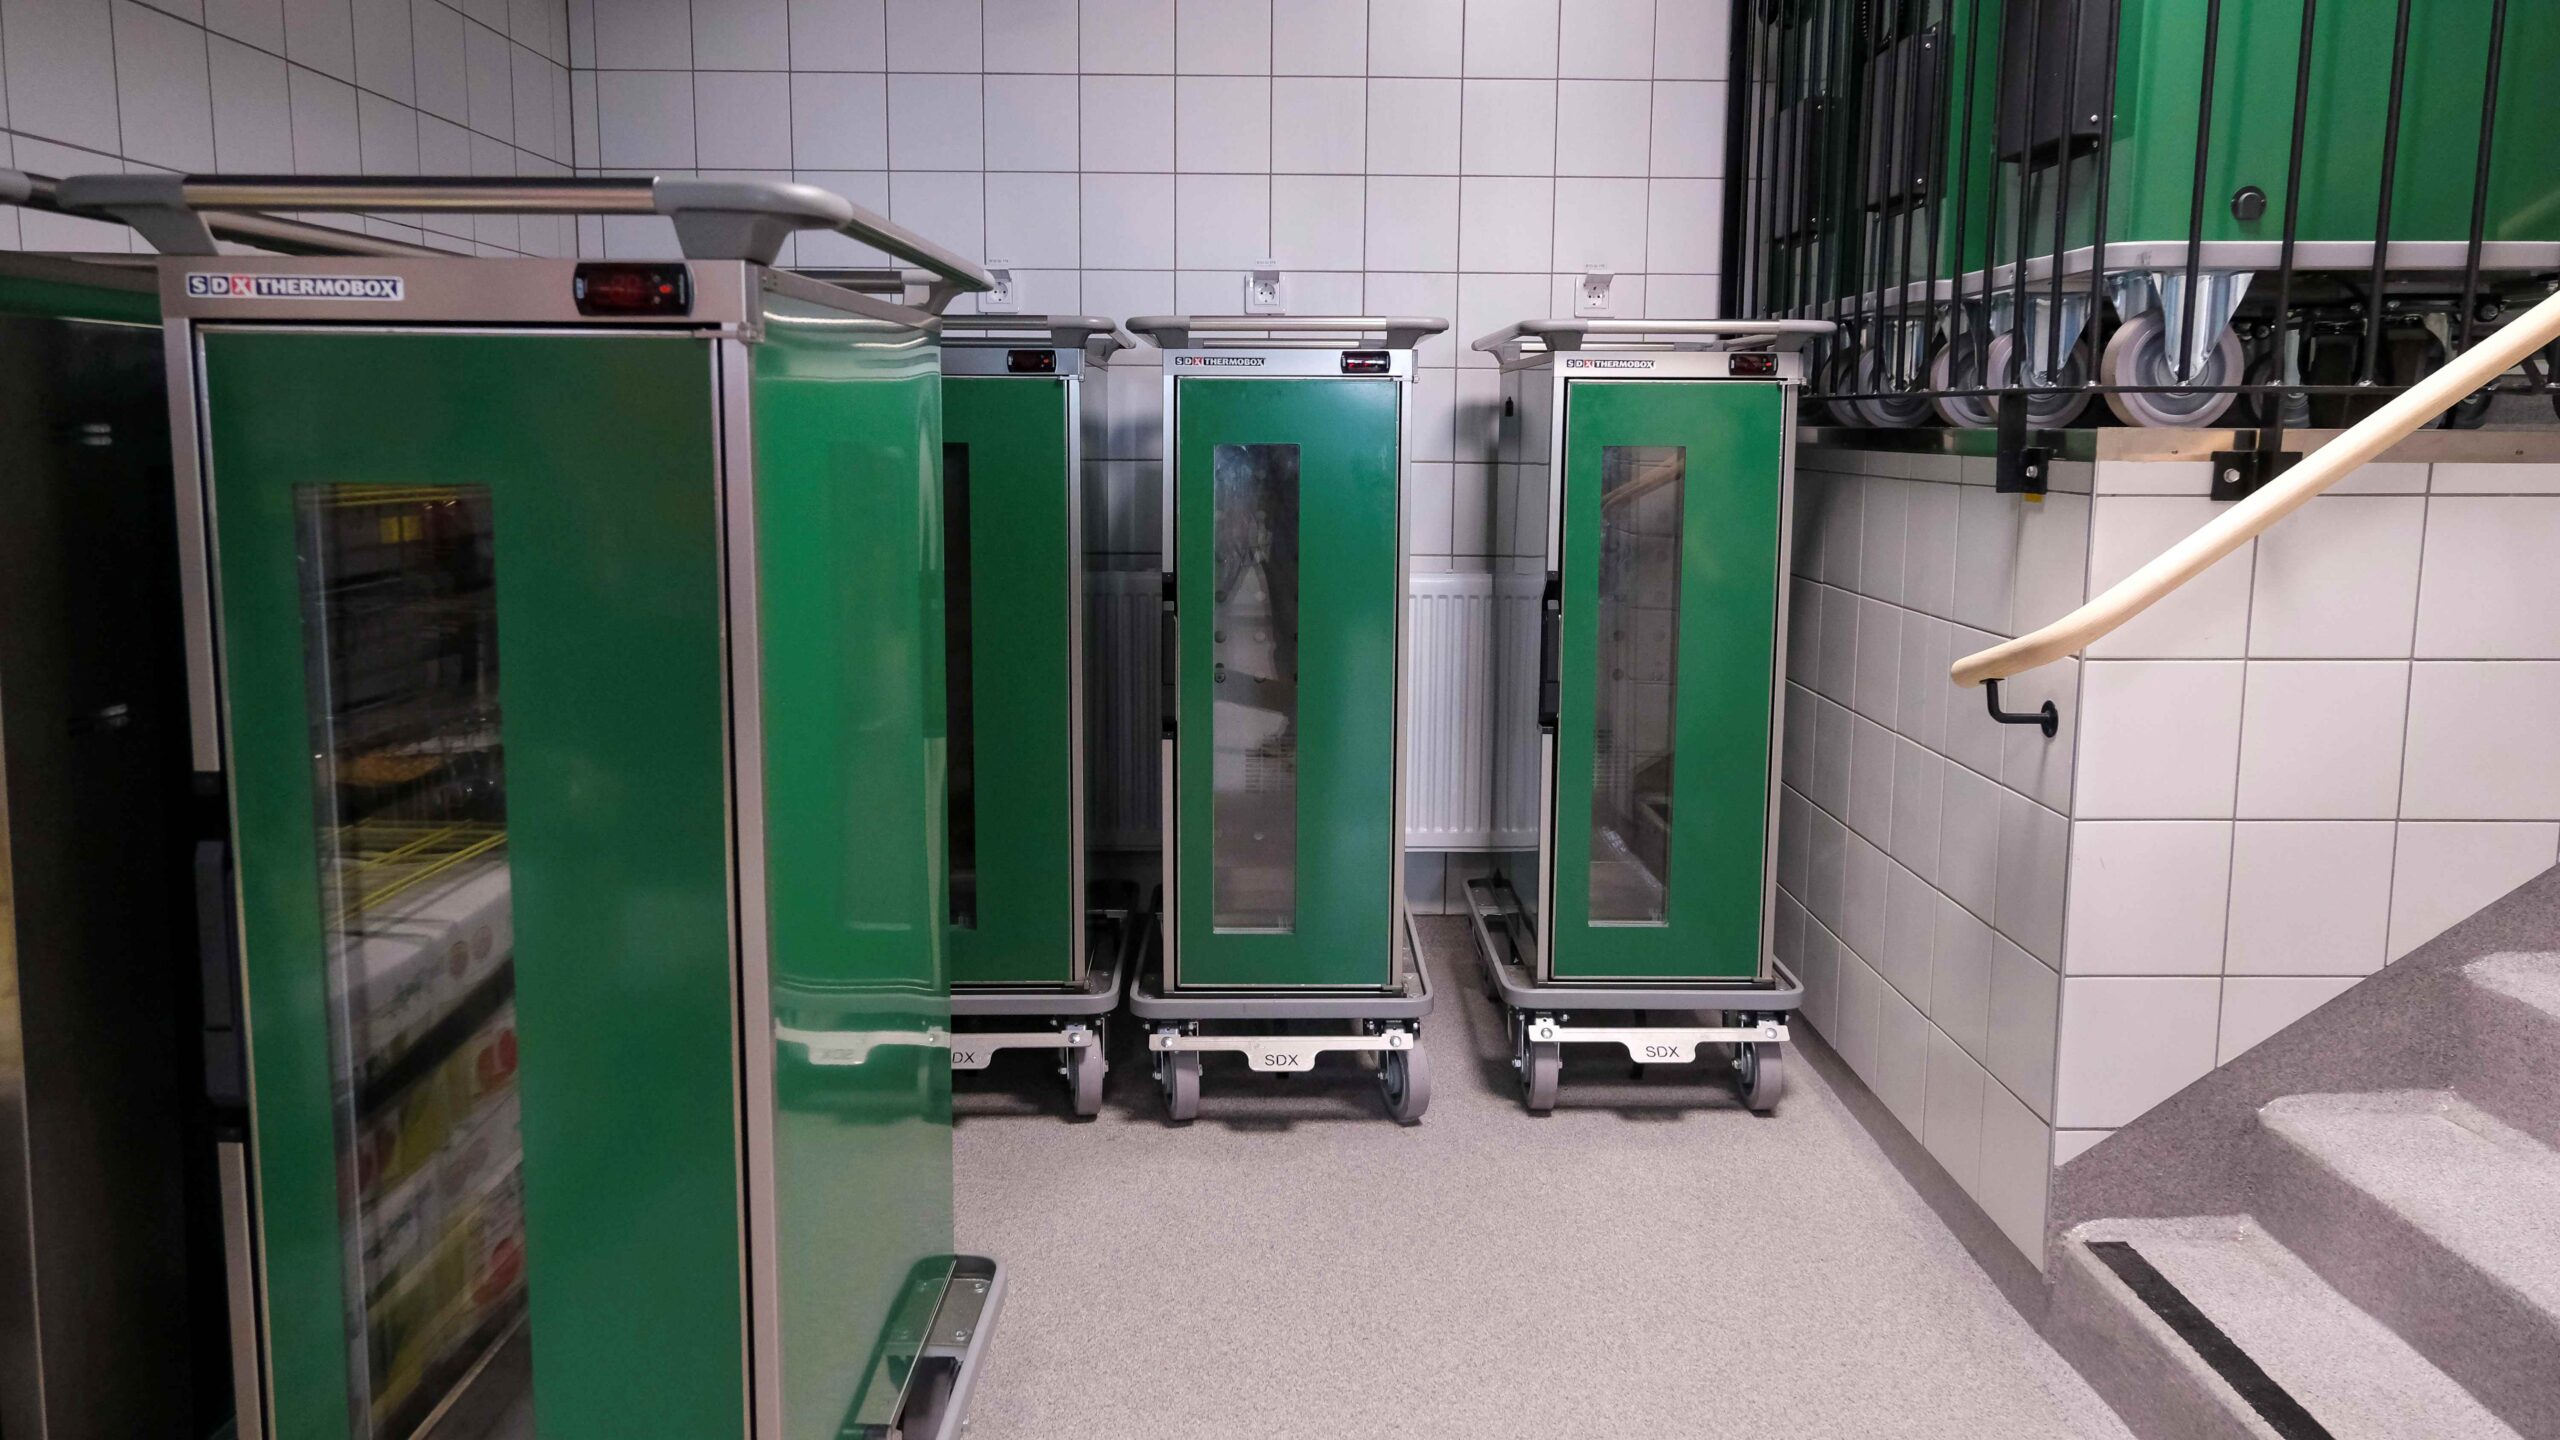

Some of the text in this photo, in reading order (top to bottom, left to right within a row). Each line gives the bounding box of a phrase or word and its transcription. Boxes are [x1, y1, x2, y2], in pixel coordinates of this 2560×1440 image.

[190, 276, 398, 298] SDX THERMOBOX
[1176, 357, 1265, 367] SDX THERMOBOX
[1567, 360, 1654, 369] SDX THERMOBOX
[951, 1051, 976, 1064] DX
[1645, 1045, 1680, 1058] SDX
[1264, 1054, 1299, 1066] SDX
